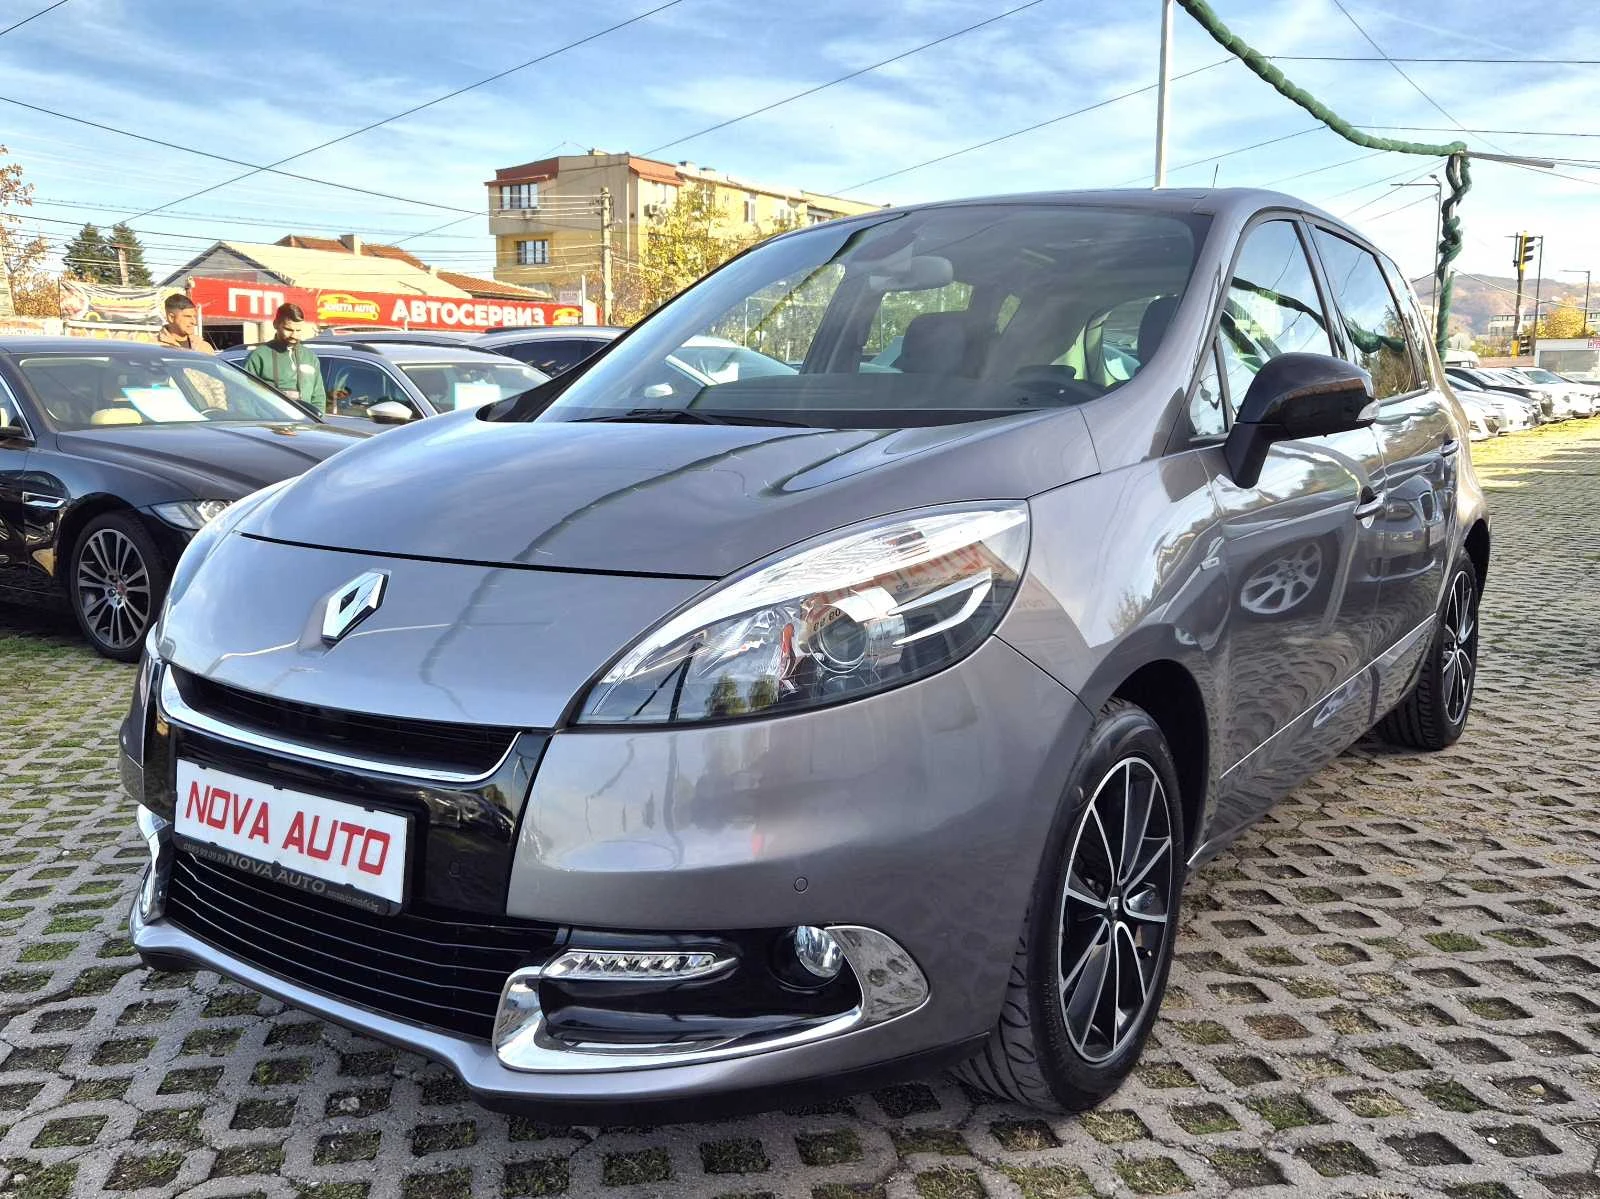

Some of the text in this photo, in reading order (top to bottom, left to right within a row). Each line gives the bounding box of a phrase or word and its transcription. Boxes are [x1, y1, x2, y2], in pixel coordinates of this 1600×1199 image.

[228, 287, 285, 316] ГТП
[391, 299, 545, 326] АВТОСЕРВИЗ
[185, 780, 391, 876] NOVA AUTO
[226, 853, 273, 878] NOVA
[276, 870, 326, 893] AUTO
